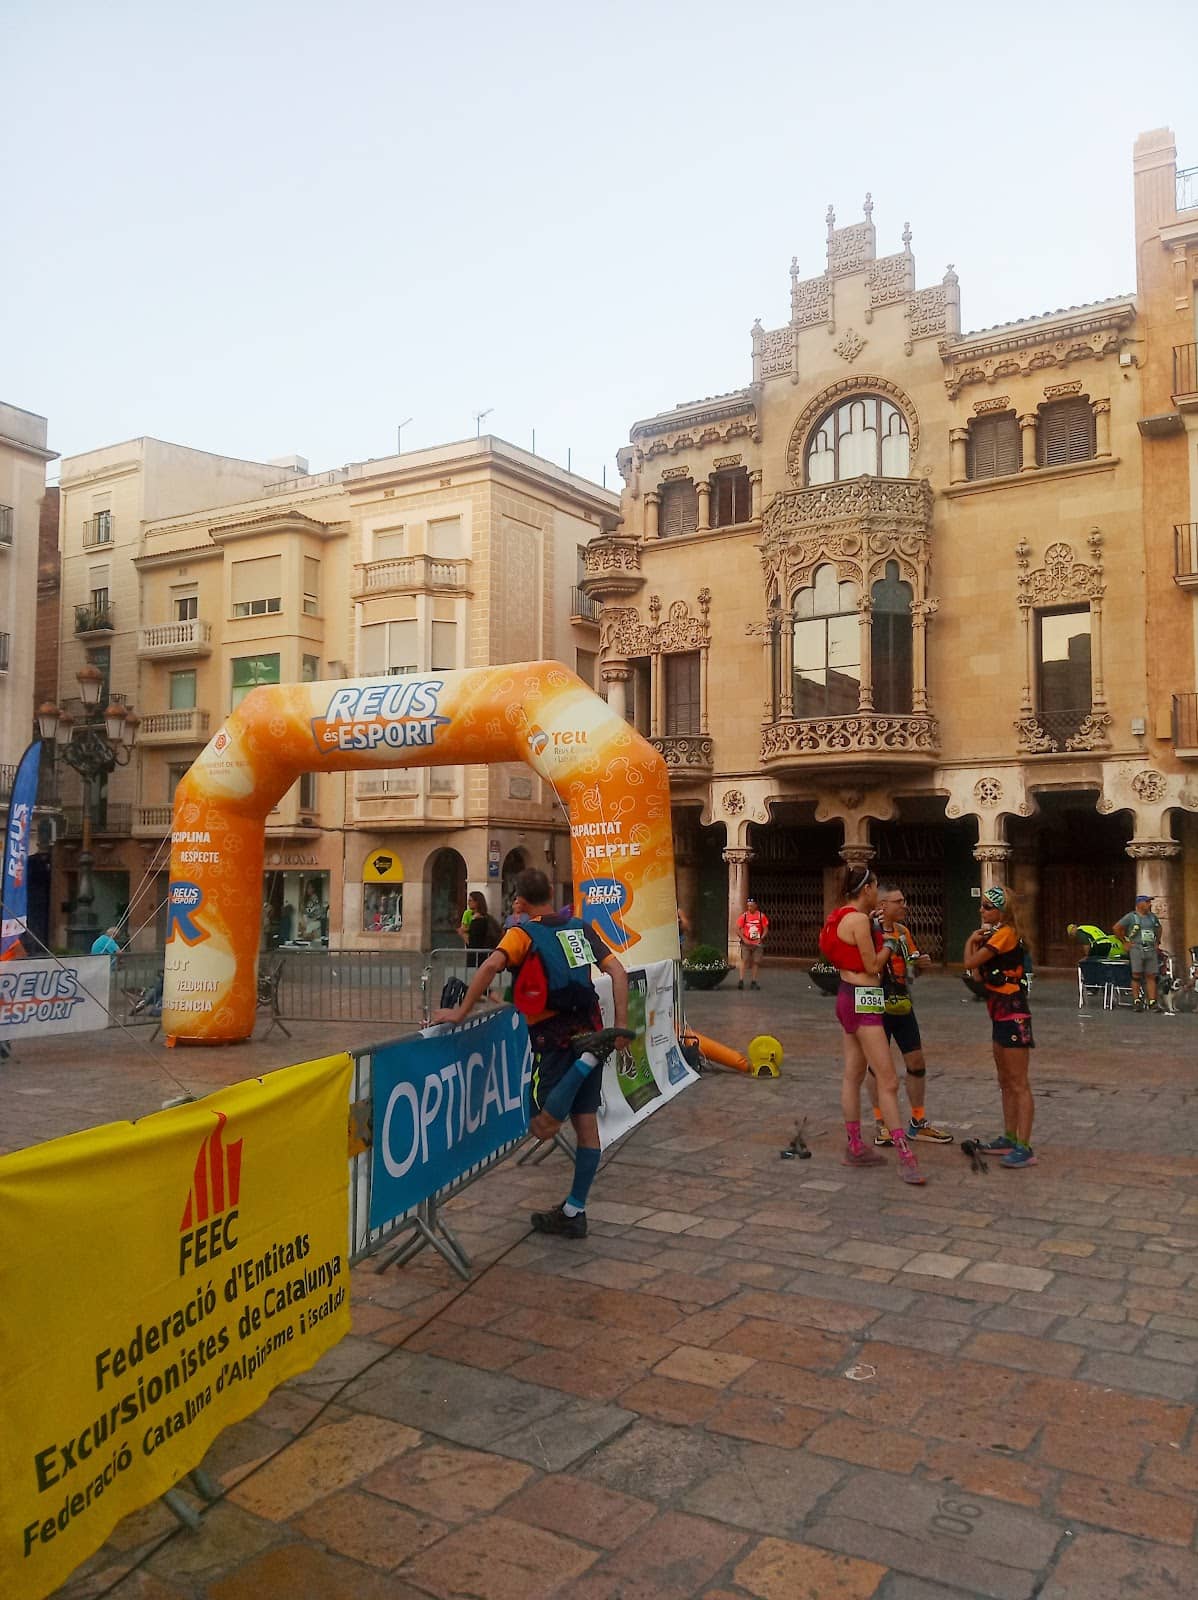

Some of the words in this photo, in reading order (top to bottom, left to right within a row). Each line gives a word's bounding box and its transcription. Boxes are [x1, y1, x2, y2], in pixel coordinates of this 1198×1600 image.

[326, 680, 444, 724] REUS
[323, 728, 338, 743] és
[338, 719, 438, 750] ESPORT
[8, 803, 27, 880] REUS
[571, 821, 622, 837] CAPACITAT
[181, 851, 220, 864] RESPECTE
[586, 842, 641, 858] REPTE
[173, 887, 200, 898] REUS
[588, 885, 622, 898] REUS
[567, 934, 585, 960] 0097
[0, 968, 78, 1003] REUS
[0, 1000, 75, 1025] ESPORT
[179, 1210, 239, 1277] FEEC
[95, 1280, 216, 1392] Federació
[224, 1233, 310, 1303] d'Entitats
[34, 1325, 230, 1494] Excursionistes
[238, 1305, 261, 1340] de
[264, 1255, 341, 1319] Catalunya
[23, 1441, 133, 1558] Federació
[300, 1313, 306, 1335] i
